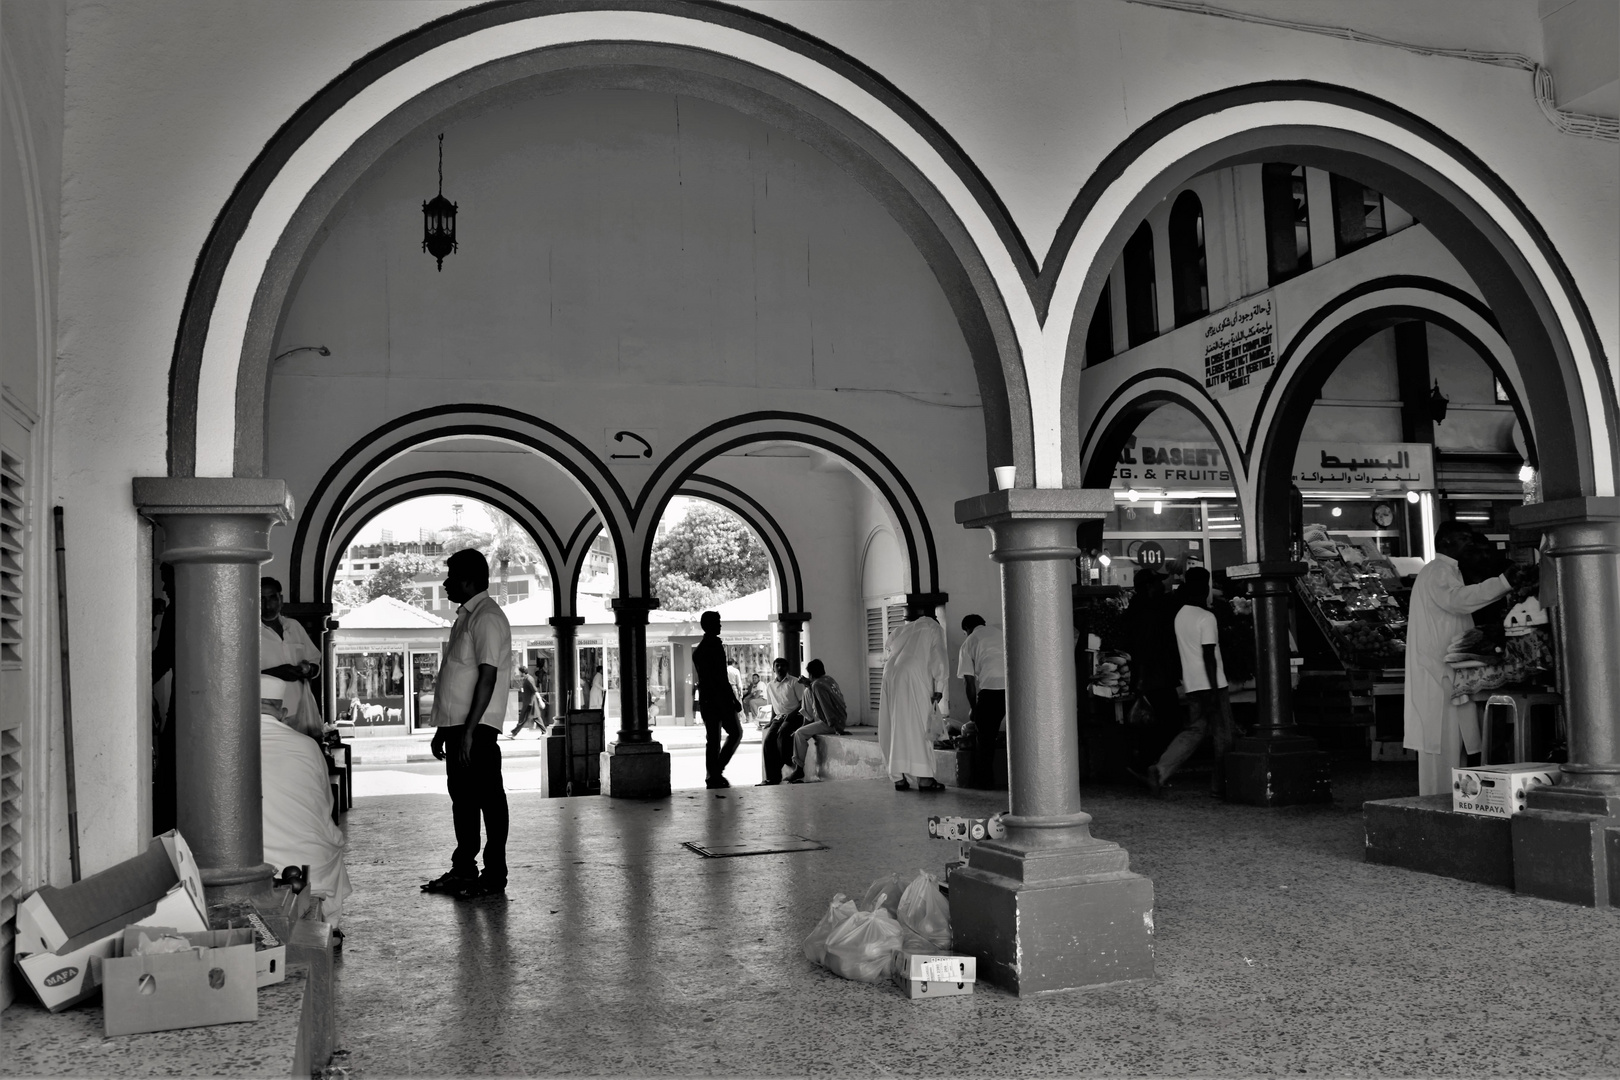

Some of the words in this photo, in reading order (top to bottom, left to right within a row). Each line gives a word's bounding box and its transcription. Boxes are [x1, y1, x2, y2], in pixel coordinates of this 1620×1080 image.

[1205, 356, 1211, 368] IN
[1210, 352, 1224, 365] CASE
[1224, 349, 1231, 360] OF
[1231, 344, 1242, 358] ANY
[1242, 333, 1273, 354] COMPLAINT
[1205, 362, 1225, 378] PLEASE
[1225, 354, 1249, 371] CONTACT
[1220, 368, 1238, 384] OFFICE
[1238, 365, 1245, 377] AT
[1246, 355, 1275, 375] VEGETABLE
[1228, 374, 1250, 390] MARKET
[1142, 446, 1220, 466] BASEET
[1321, 450, 1409, 471] البسيط
[1144, 468, 1157, 480] &
[1165, 469, 1231, 481] FRUITS
[1355, 472, 1419, 483] للخضروات
[1141, 550, 1162, 564] 101
[1475, 804, 1505, 814] PAPAYA
[46, 968, 77, 986] MAFA
